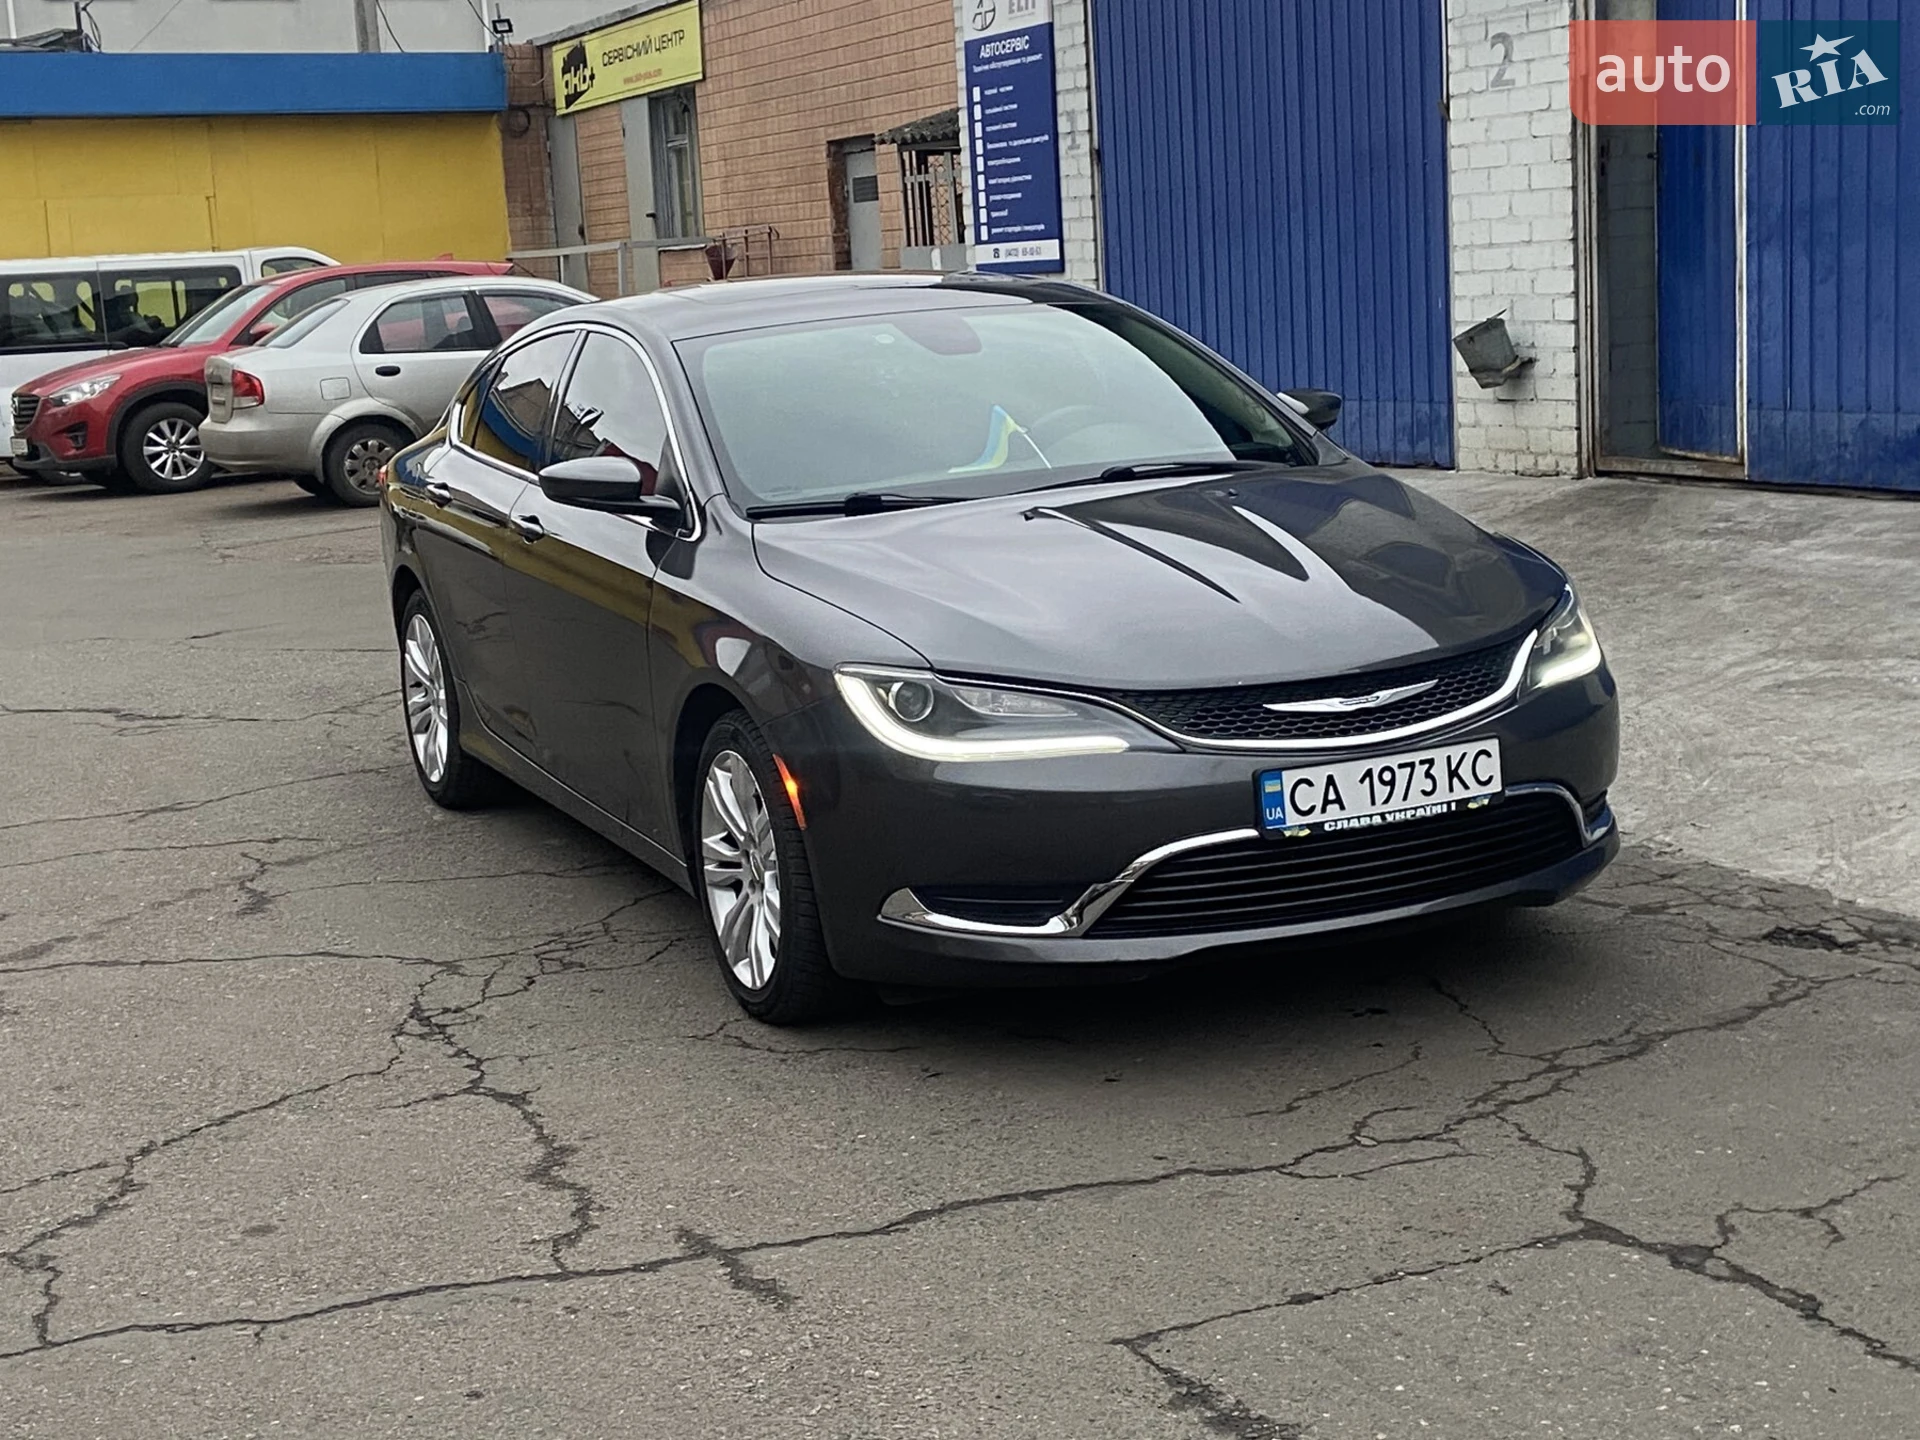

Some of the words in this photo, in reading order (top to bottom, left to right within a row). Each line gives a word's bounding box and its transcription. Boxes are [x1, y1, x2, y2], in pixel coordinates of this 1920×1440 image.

[602, 36, 653, 67] СЕРВІСНИЙ
[655, 29, 685, 54] ЦЕНТР
[979, 35, 1030, 59] АВТОСЕРВІС
[1490, 31, 1516, 88] 2
[1289, 773, 1346, 817] CA
[1358, 757, 1437, 806] 1973
[1446, 748, 1494, 793] KC
[1266, 807, 1284, 820] UA
[1324, 814, 1382, 831] СЛАВА
